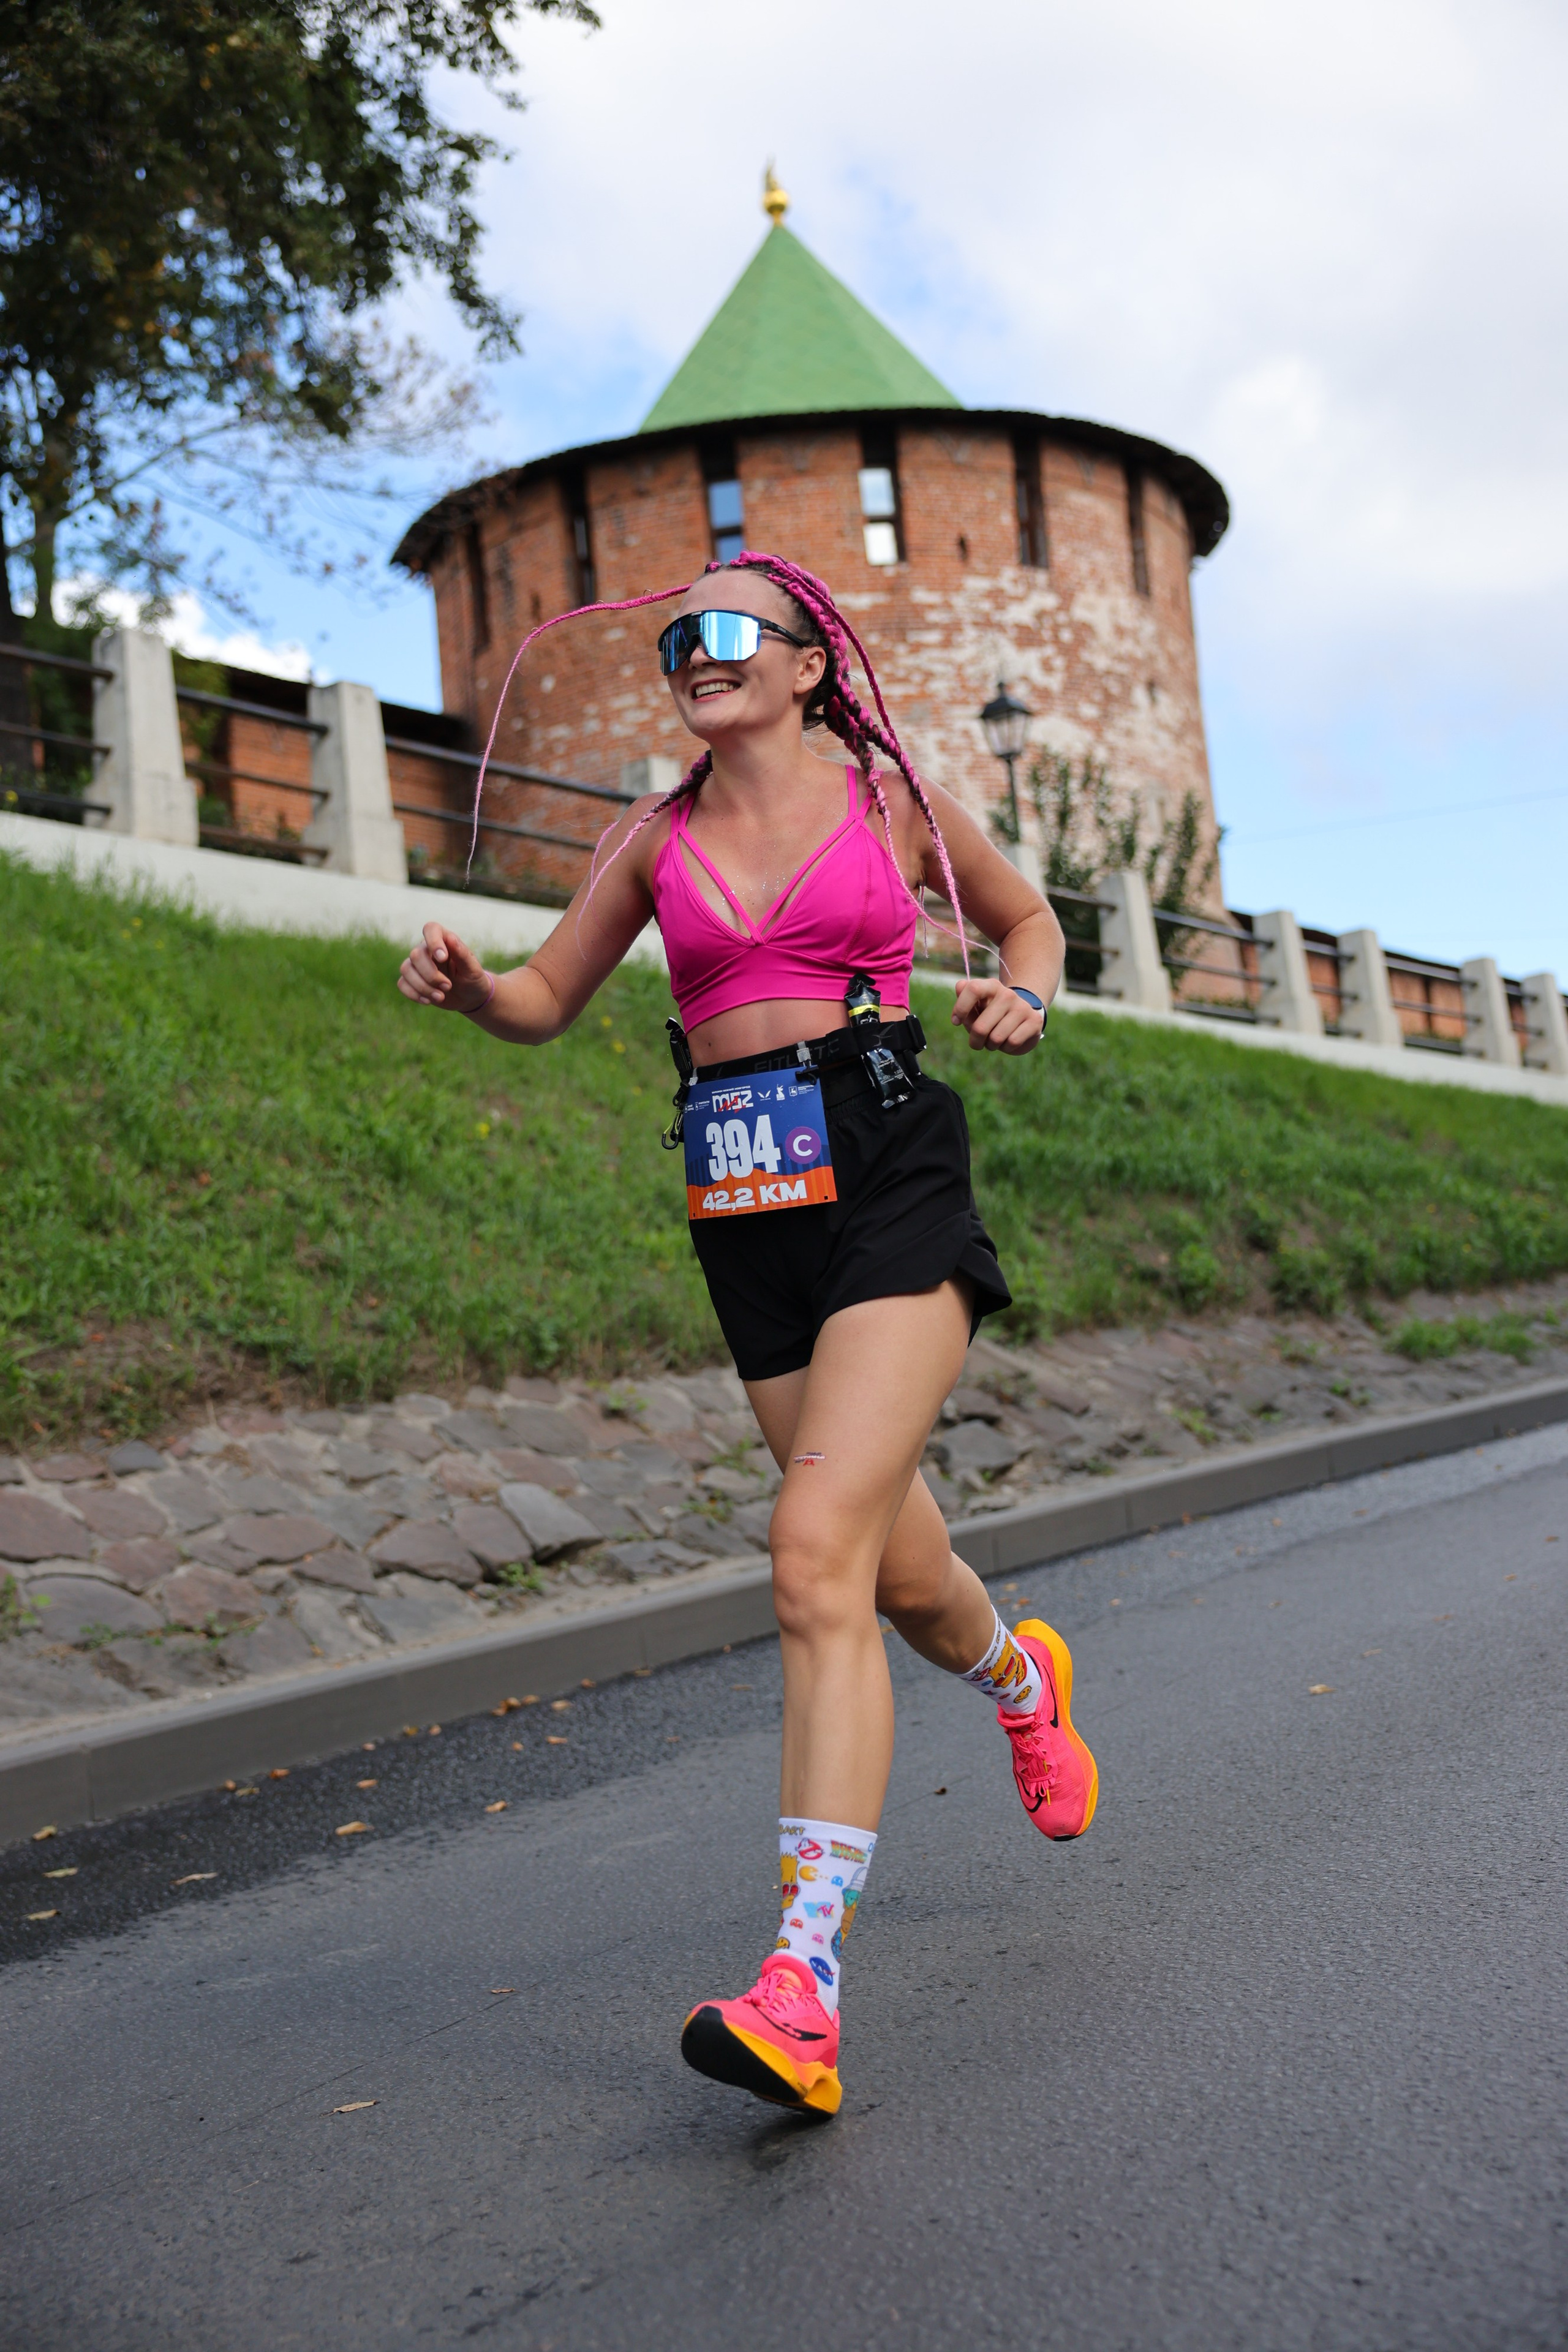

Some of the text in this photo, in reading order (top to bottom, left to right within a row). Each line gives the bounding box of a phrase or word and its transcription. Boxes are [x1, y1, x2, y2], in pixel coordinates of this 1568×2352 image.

[706, 1114, 782, 1182] 394
[793, 1134, 813, 1156] C
[703, 1187, 756, 1212] 42,2
